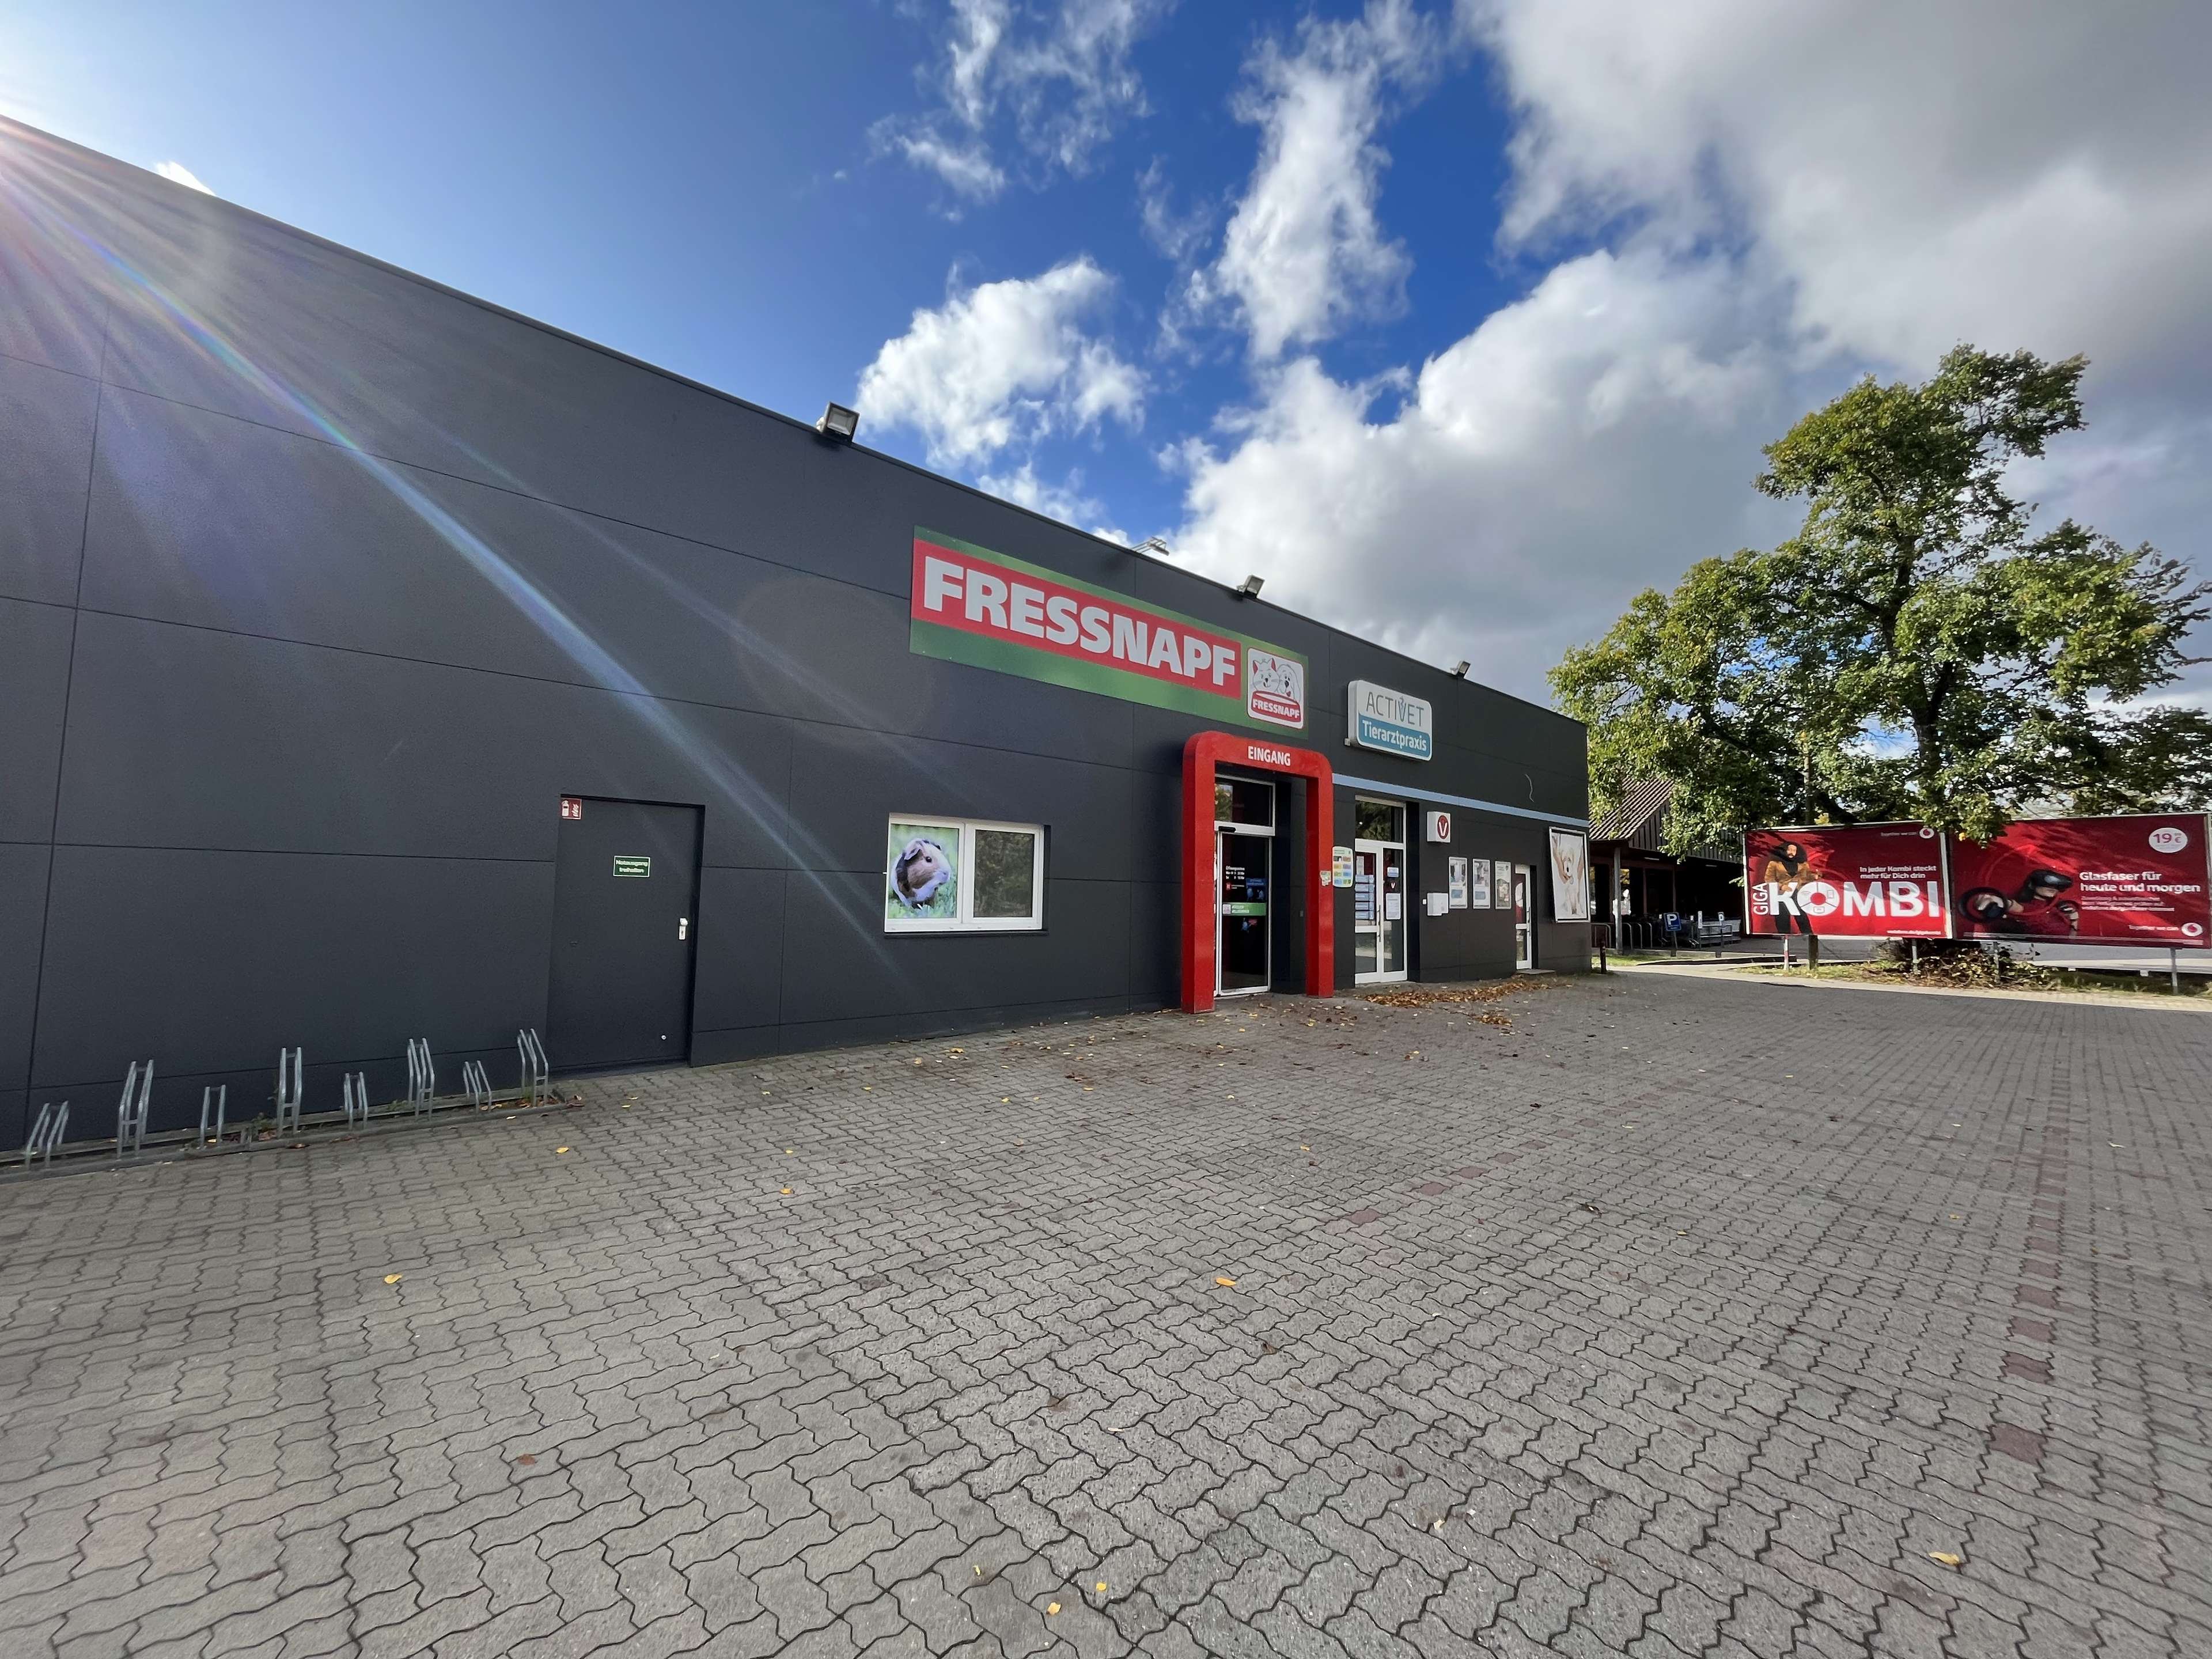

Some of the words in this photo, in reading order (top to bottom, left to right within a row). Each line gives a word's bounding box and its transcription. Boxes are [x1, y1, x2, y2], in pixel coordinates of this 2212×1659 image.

[923, 555, 1236, 686] FRESSNAPF
[1252, 699, 1300, 718] FRESSNAPF
[1366, 691, 1425, 727] ACTIVET
[1362, 719, 1427, 751] Tierarztpraxis
[1248, 745, 1291, 767] EINGANG
[2079, 871, 2139, 881] Glasfaser
[2141, 871, 2162, 881] für
[2080, 882, 2118, 892] heute
[2119, 882, 2145, 892] und
[2146, 884, 2201, 894] morgen
[1752, 882, 1769, 915] GIGA
[1768, 881, 1941, 918] KOMBI
[1666, 914, 1677, 925] P
